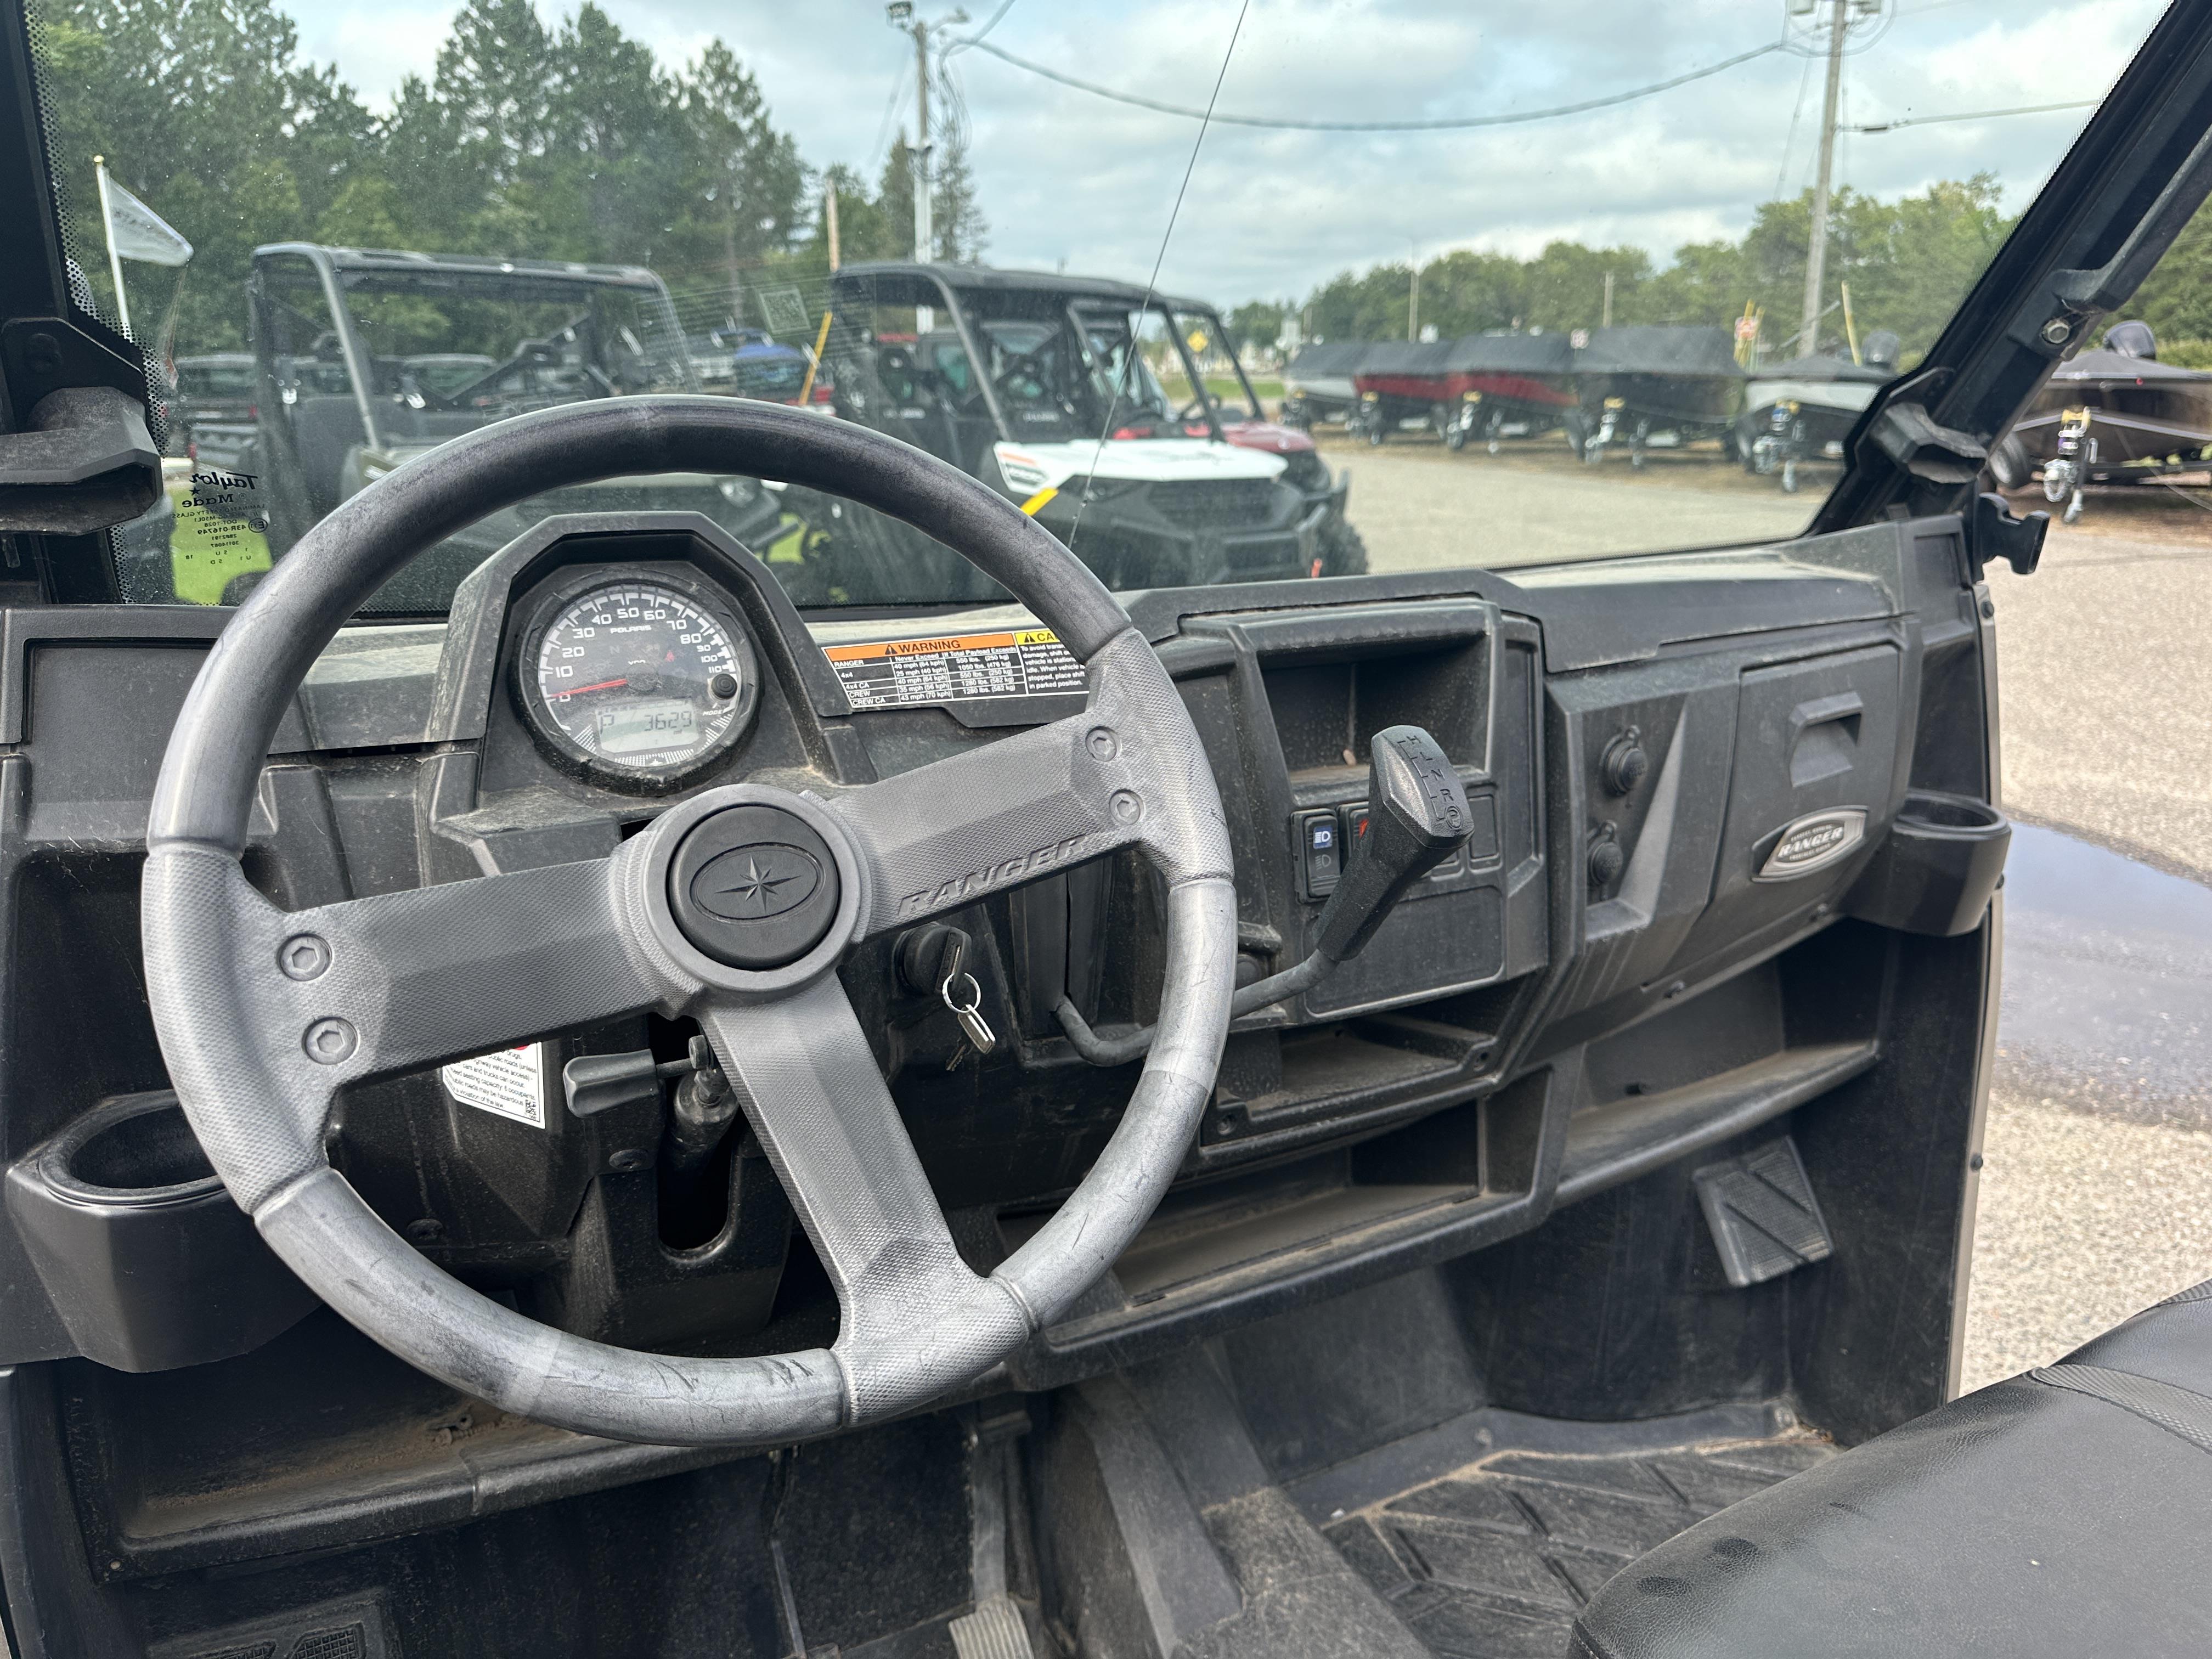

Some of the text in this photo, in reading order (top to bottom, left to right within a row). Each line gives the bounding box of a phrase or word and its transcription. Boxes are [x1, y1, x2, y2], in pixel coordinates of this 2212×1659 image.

[617, 607, 640, 618] 50
[644, 610, 666, 620] 60
[592, 614, 612, 624] 40
[667, 619, 687, 630] 70
[572, 628, 595, 639] 30
[610, 625, 652, 634] POLARIS
[680, 633, 702, 644] 80
[562, 646, 585, 658] 20
[610, 646, 620, 654] N
[898, 640, 961, 653] WARNING
[556, 665, 573, 678] 10
[1036, 681, 1057, 690] parked
[559, 692, 571, 702] 0
[644, 711, 692, 731] 3629
[1406, 735, 1421, 744] H
[1420, 752, 1432, 761] L
[1431, 769, 1445, 781] N
[1440, 789, 1454, 802] R
[1778, 827, 1843, 857] RANGER
[898, 834, 1088, 916] RANGER
